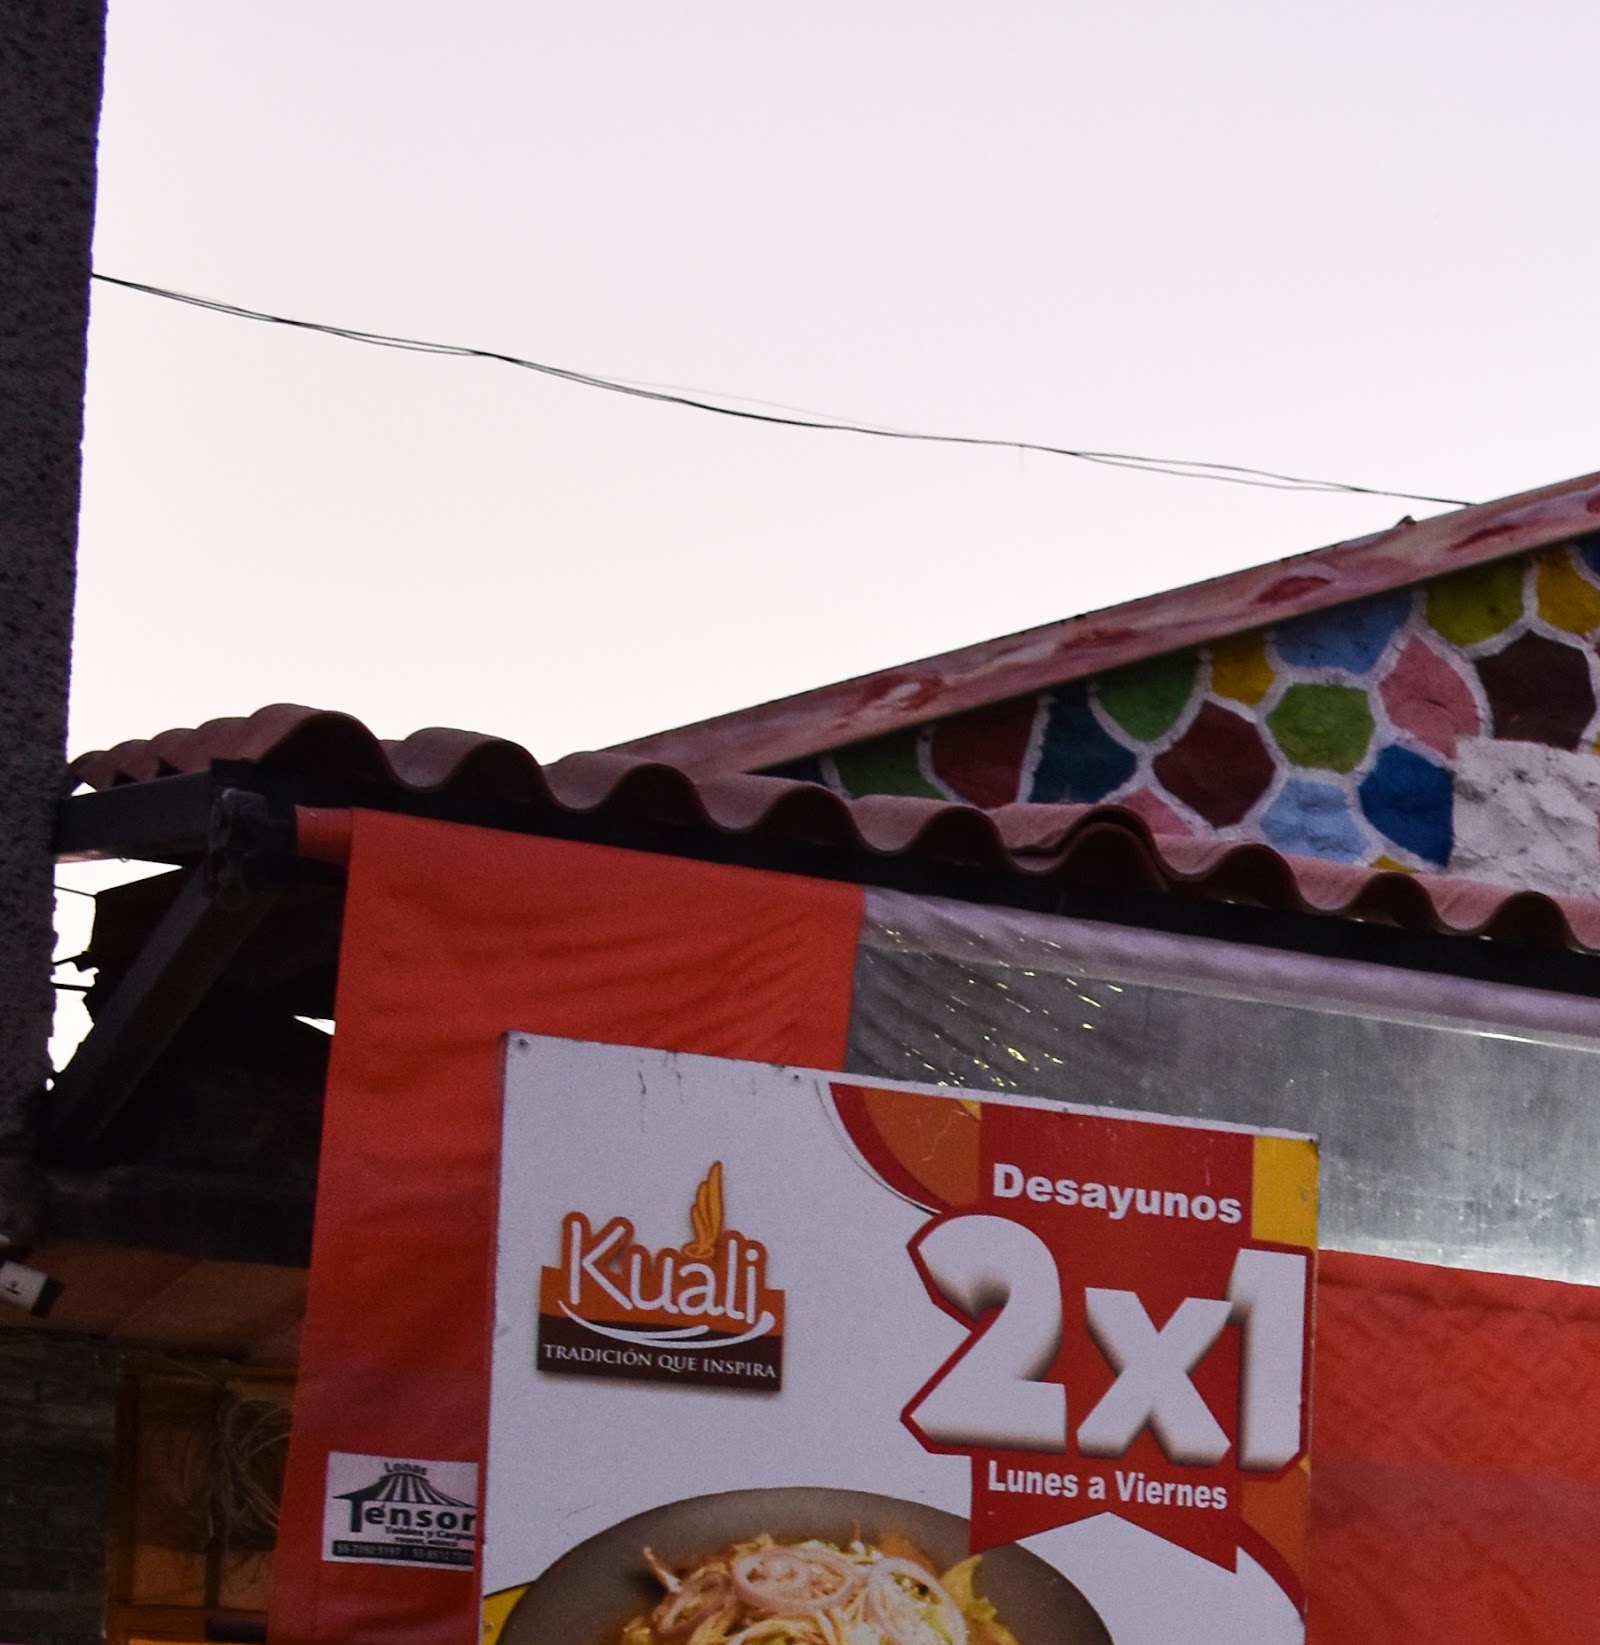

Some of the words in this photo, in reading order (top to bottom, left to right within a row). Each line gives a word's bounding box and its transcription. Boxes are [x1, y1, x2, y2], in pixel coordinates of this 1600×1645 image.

[992, 1162, 1243, 1226] Desayunos
[566, 1217, 768, 1327] Kuali
[543, 1341, 653, 1369] TRADICIÓN
[658, 1354, 698, 1374] QUE
[703, 1356, 778, 1380] INSPIRA
[916, 1214, 1308, 1471] 2x1
[988, 1460, 1079, 1500] Lunes
[1087, 1477, 1106, 1501] a
[1114, 1471, 1228, 1511] Viernes
